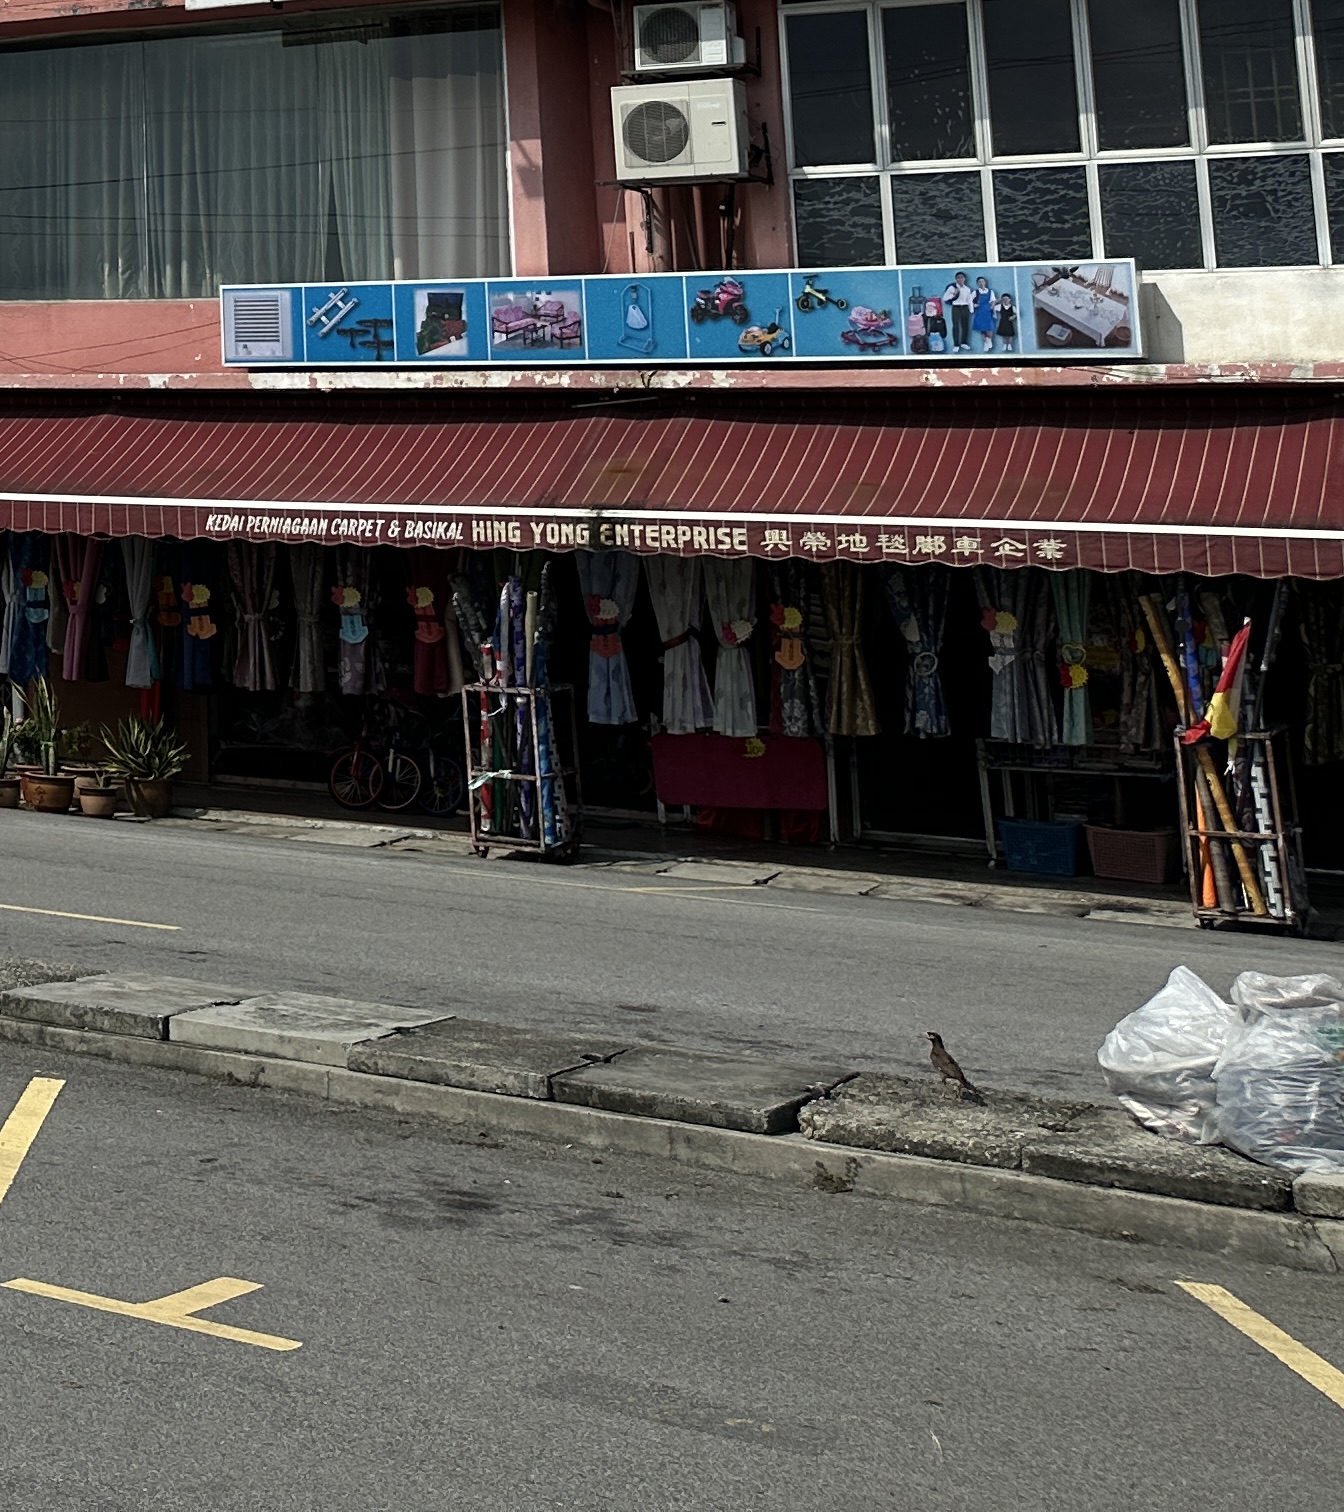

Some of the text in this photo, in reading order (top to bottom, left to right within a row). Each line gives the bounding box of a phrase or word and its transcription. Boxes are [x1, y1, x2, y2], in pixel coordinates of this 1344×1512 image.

[205, 514, 245, 532] KEDAI
[246, 515, 328, 535] PERNIAGAAN
[331, 519, 385, 537] CARPET
[387, 521, 401, 538] &
[404, 520, 464, 540] BASIKAL
[472, 520, 521, 544] HING
[529, 522, 590, 545] YONG
[600, 523, 748, 550] ENTERPRISE
